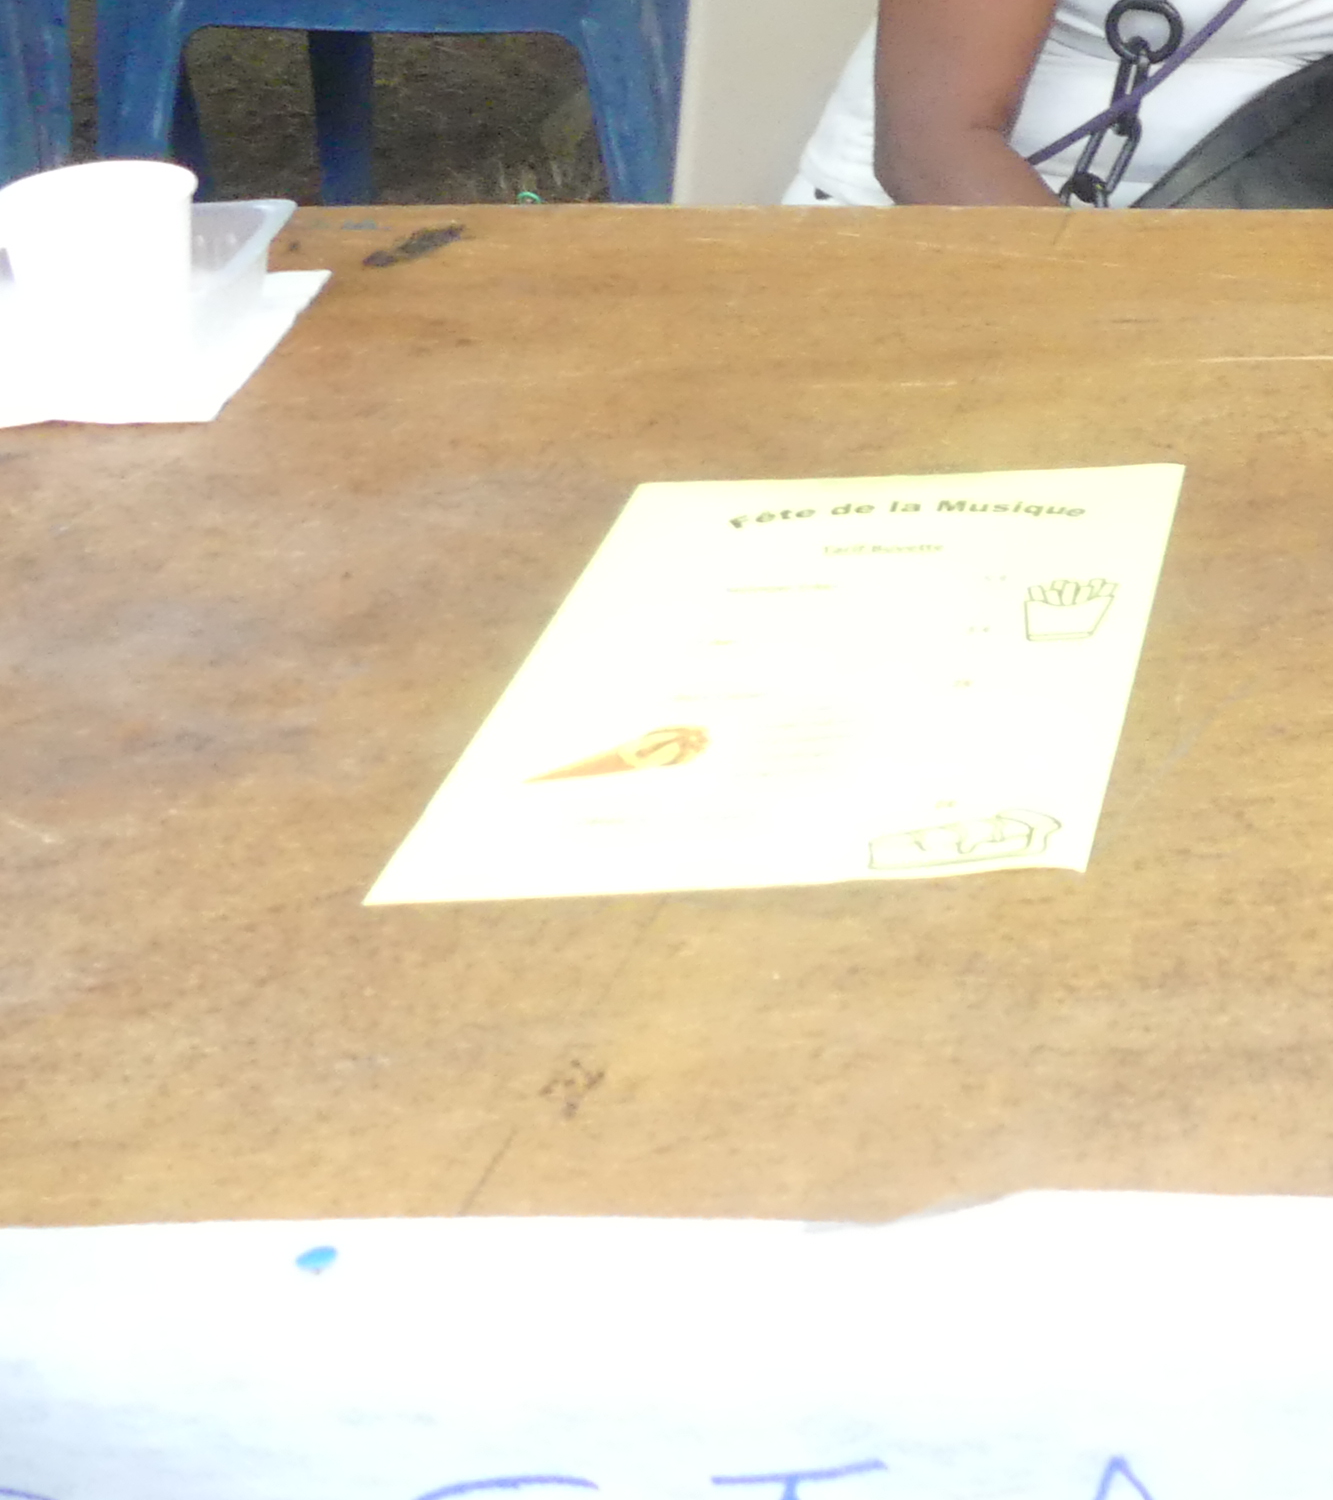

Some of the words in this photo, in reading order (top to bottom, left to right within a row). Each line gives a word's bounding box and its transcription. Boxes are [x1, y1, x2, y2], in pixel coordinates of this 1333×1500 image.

[831, 503, 876, 516] de
[889, 501, 922, 513] la
[937, 500, 1086, 517] Musique
